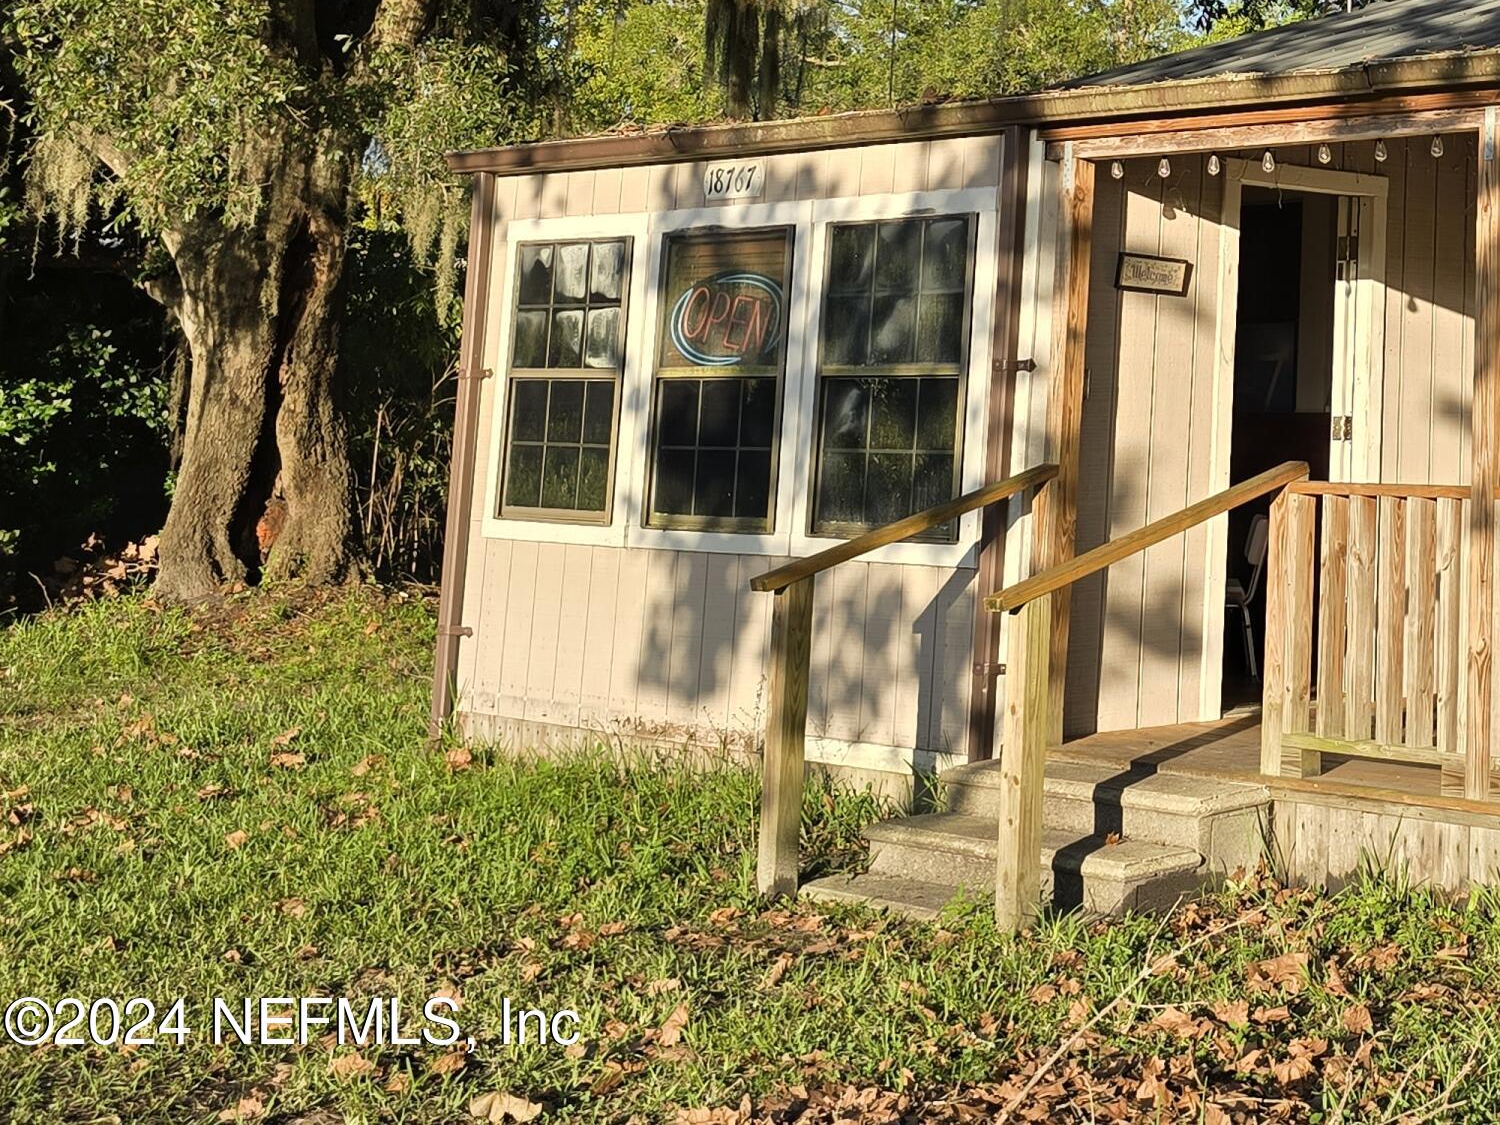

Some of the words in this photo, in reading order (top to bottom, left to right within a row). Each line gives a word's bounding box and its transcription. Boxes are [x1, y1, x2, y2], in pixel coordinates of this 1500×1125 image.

[707, 165, 757, 195] 18767
[1130, 264, 1174, 285] Welcome
[683, 286, 773, 352] OPEN
